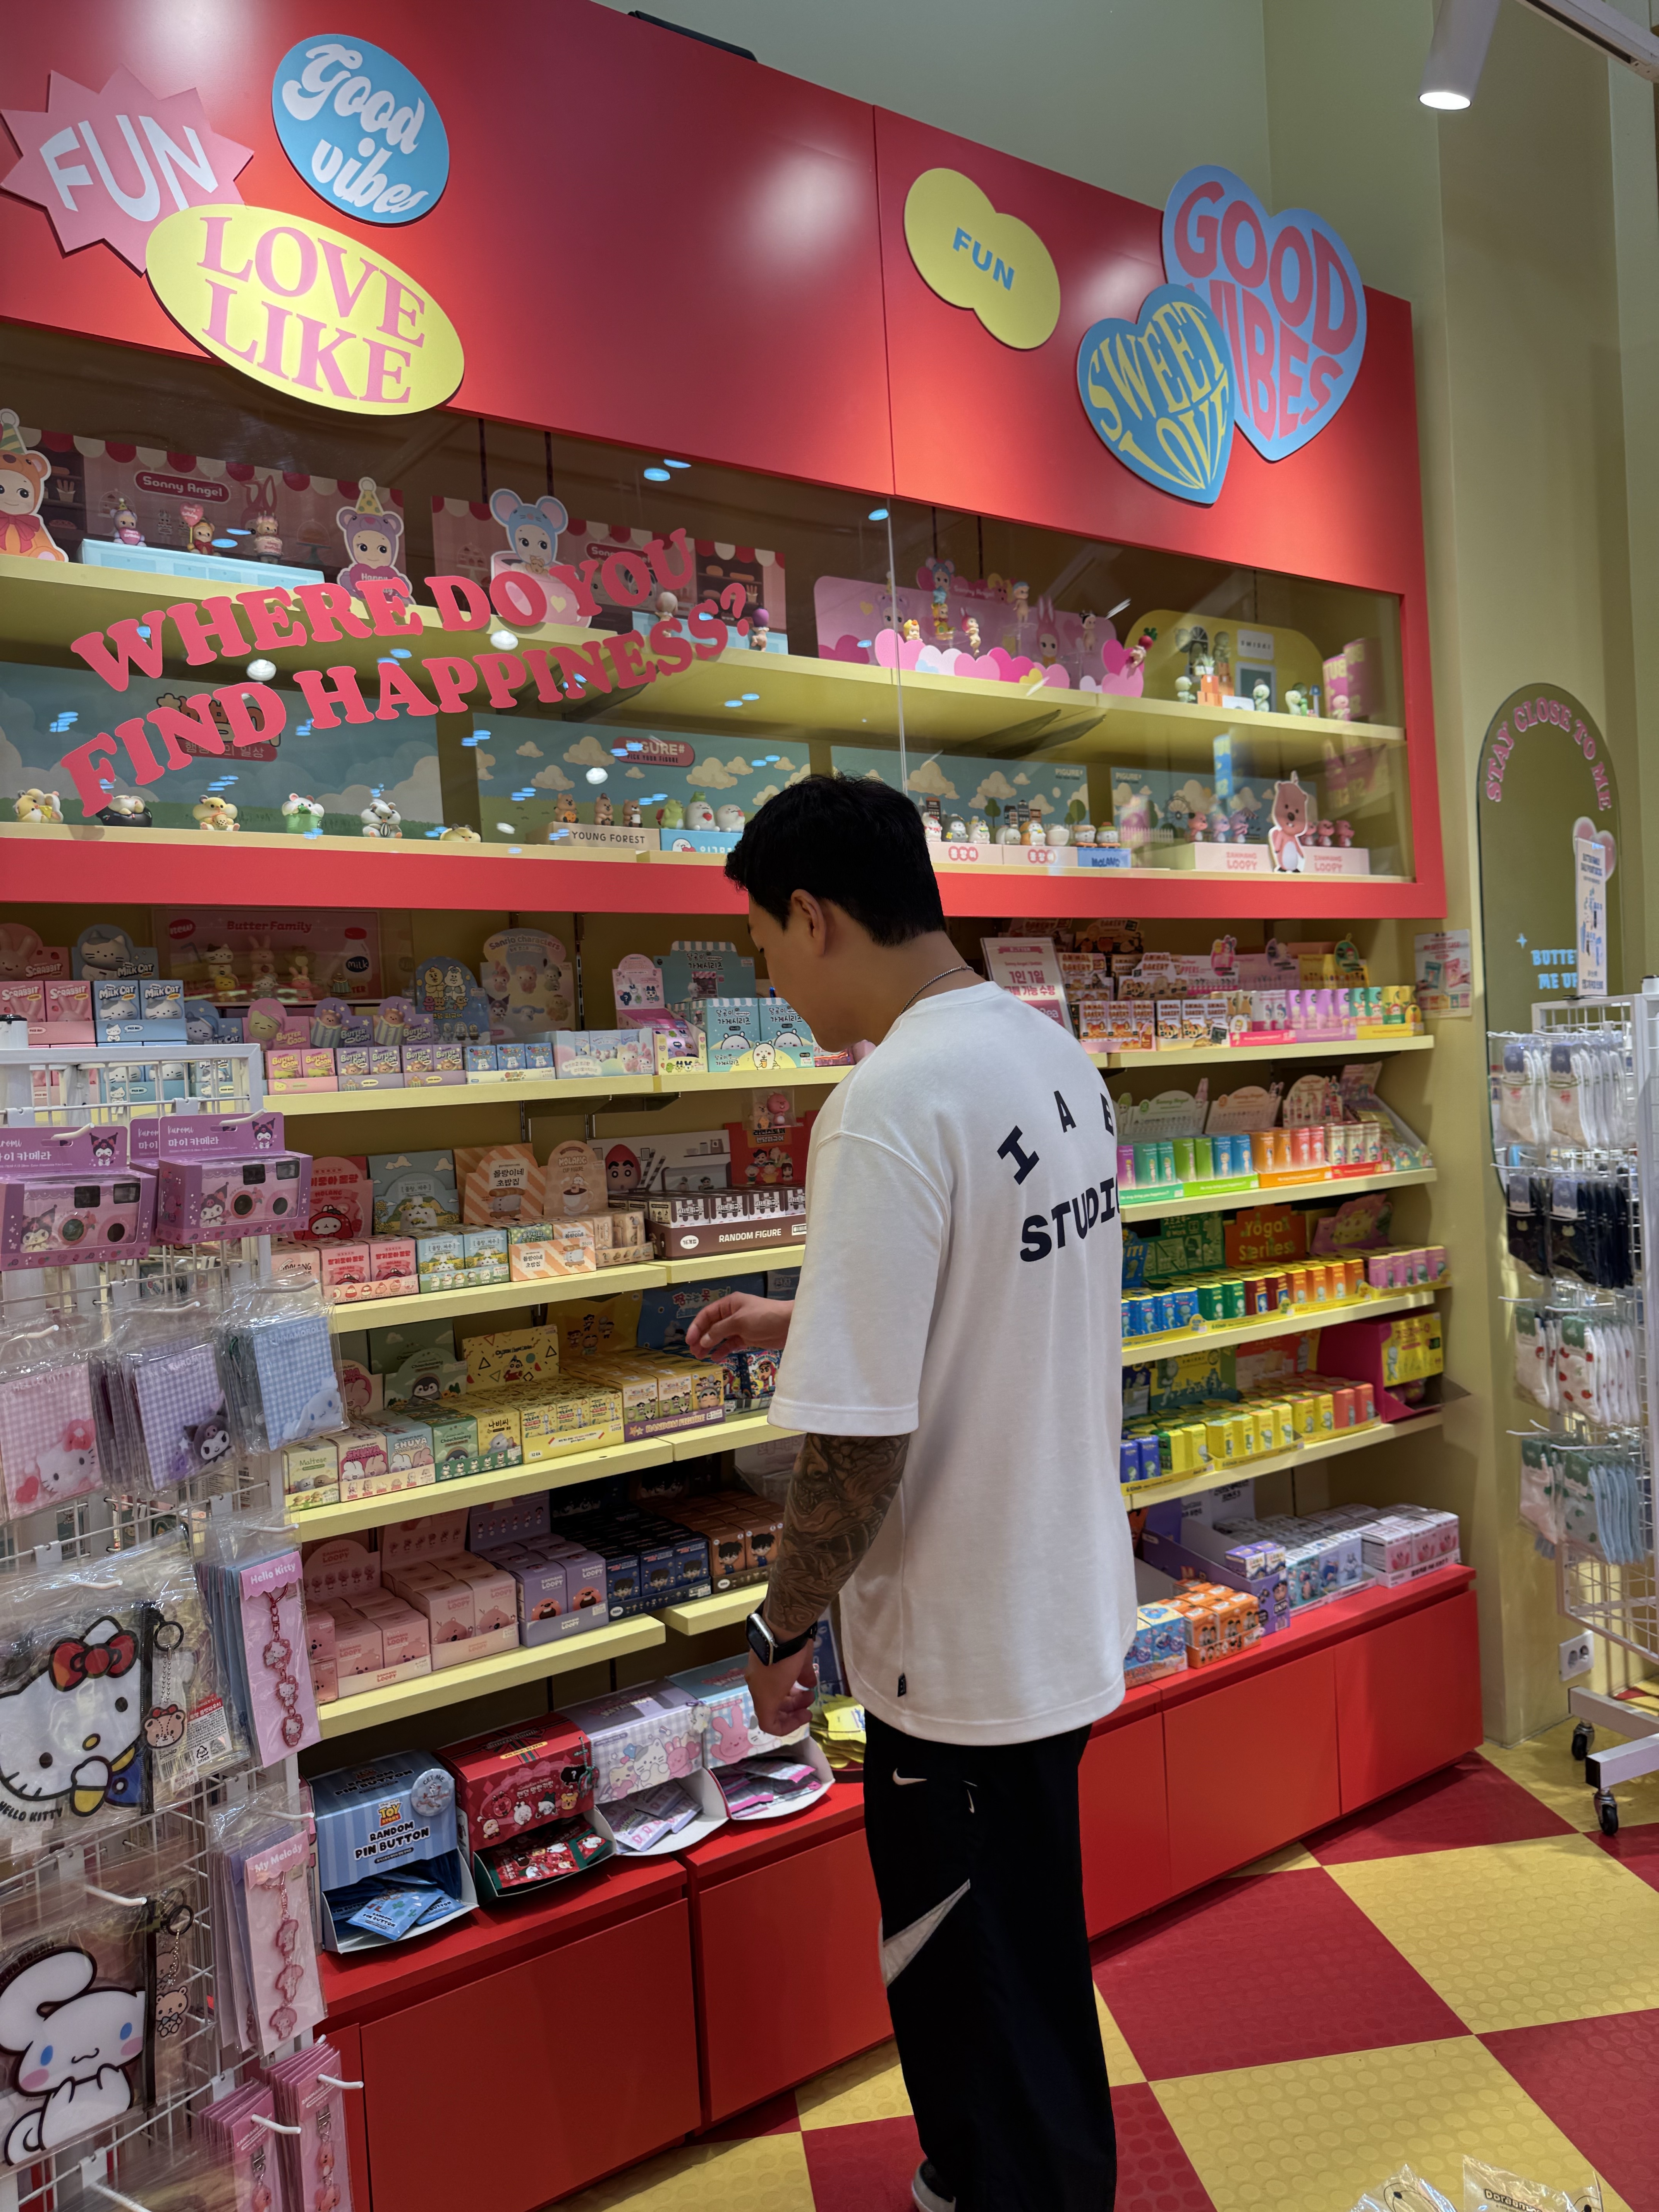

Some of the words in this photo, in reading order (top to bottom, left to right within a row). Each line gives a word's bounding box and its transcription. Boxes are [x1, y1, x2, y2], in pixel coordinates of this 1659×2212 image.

[282, 44, 425, 154] Good
[39, 115, 218, 221] FUN
[311, 137, 429, 213] vibes
[952, 227, 1015, 291] FUN
[1174, 180, 1357, 356] GOOD
[196, 217, 425, 348] LOVE
[202, 279, 411, 403] LIKE
[1088, 301, 1225, 442] SWEET
[1119, 370, 1230, 490] LOVE
[143, 476, 184, 493] Sonny
[187, 483, 223, 498] Angel
[70, 577, 424, 692] WHERE
[424, 571, 547, 631] DO
[548, 528, 693, 617] YOU
[60, 682, 287, 817] FIND
[292, 582, 750, 729] HAPPINESS?
[240, 745, 264, 758] 일상
[1486, 721, 1514, 802] STAY
[1513, 697, 1571, 732] CLOSE
[1575, 720, 1596, 761] TO
[1591, 761, 1611, 811] ME
[572, 831, 606, 842] YOUNG
[610, 834, 645, 844] FOREST
[1227, 860, 1257, 871] LOOPY
[1315, 862, 1343, 872] LOOPY
[227, 921, 267, 931] Butter
[270, 921, 312, 933] Family
[489, 936, 516, 950] Sanrio
[517, 936, 562, 951] characters
[1531, 949, 1577, 966] BUTTE
[117, 966, 135, 978] MILK
[136, 963, 155, 974] CAT
[688, 962, 724, 970] 가게시리즈
[1009, 971, 1026, 984] 1인
[1027, 970, 1045, 984] 1일
[1538, 973, 1559, 989] ME
[1, 986, 40, 1001] SCRABBIT
[50, 985, 87, 1000] SCRABBIT
[99, 988, 120, 1000] MILK
[120, 984, 136, 995] CAT
[144, 987, 165, 1000] MILK
[166, 984, 182, 995] CAT
[1022, 985, 1038, 996] 가능
[1040, 985, 1055, 996] 수량
[718, 1016, 751, 1025] 가게시리즈
[304, 1054, 328, 1065] BUTTER
[341, 1052, 362, 1064] BUTTER
[372, 1051, 393, 1062] BUTTER
[406, 1050, 427, 1061] BUTTER
[436, 1048, 457, 1060] BUTTER
[272, 1057, 295, 1068] BUTTER
[168, 1125, 194, 1135] Kuromi
[139, 1141, 158, 1149] 마이
[168, 1139, 188, 1147] 마이
[190, 1136, 220, 1146] 카메라
[17, 1151, 52, 1161] 카메라
[558, 1156, 587, 1167] MOLANG
[996, 1125, 1040, 1185] I
[493, 1168, 524, 1178] 몰랑이네
[496, 1178, 520, 1187] 초밥집
[1020, 1173, 1120, 1262] STUDI
[719, 1231, 753, 1243] RANDOM
[755, 1228, 782, 1240] FIGURE
[1244, 1220, 1283, 1238] Yoga
[1127, 1245, 1143, 1258] IT!
[1239, 1239, 1294, 1262] Series
[488, 1418, 508, 1427] 나비씨
[645, 1419, 678, 1433] RANDOM
[678, 1414, 706, 1426] FIGURE
[394, 1437, 427, 1449] SHUYA
[346, 1444, 380, 1459] SHUYA
[300, 1457, 327, 1466] Maltese
[323, 1551, 350, 1564] LOOPY
[251, 1571, 273, 1585] Hello
[274, 1563, 296, 1576] Kitty
[582, 1568, 604, 1578] LOOPY
[542, 1579, 563, 1590] LOOPY
[448, 1599, 470, 1611] LOOPY
[562, 1621, 579, 1630] LOOPY
[387, 1637, 409, 1647] LOOPY
[340, 1648, 362, 1658] LOOPY
[377, 1674, 397, 1683] LOOPY
[335, 1785, 359, 1796] PIN
[359, 1769, 414, 1788] BUTTON
[346, 1770, 394, 1787] RANDOM
[422, 1774, 434, 1785] GET
[436, 1774, 445, 1782] ME
[0, 1801, 27, 1821] HELLO
[29, 1808, 63, 1822] KITTY
[378, 1803, 402, 1820] TOY
[380, 1815, 401, 1826] STORY
[370, 1820, 414, 1842] RANDOM
[354, 1844, 376, 1859] PIN
[379, 1827, 430, 1852] BUTTON
[254, 1861, 269, 1874] My
[271, 1844, 303, 1864] Melody
